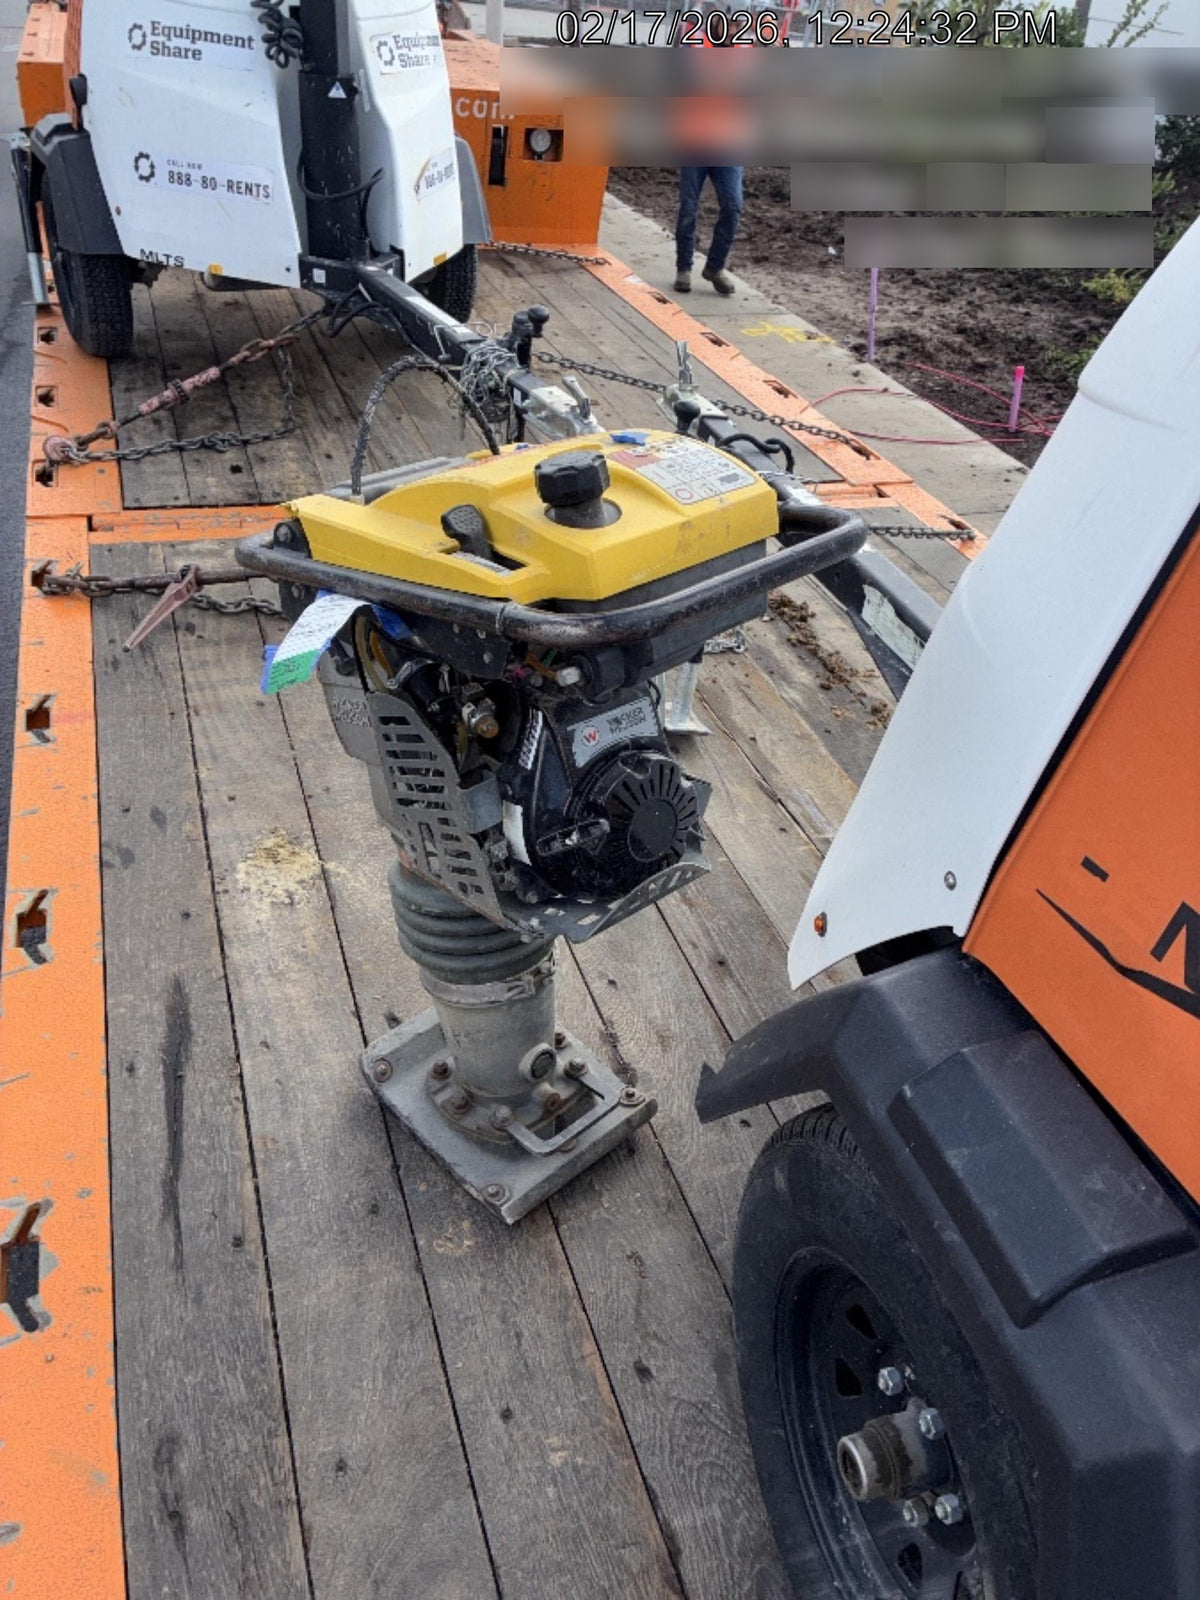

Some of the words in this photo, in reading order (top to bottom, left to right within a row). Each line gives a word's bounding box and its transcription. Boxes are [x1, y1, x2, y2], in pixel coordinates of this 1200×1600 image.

[150, 20, 255, 50] Equipment
[150, 40, 202, 61] Share
[168, 169, 271, 199] 888-80-RENTS
[139, 248, 185, 267] MLTS
